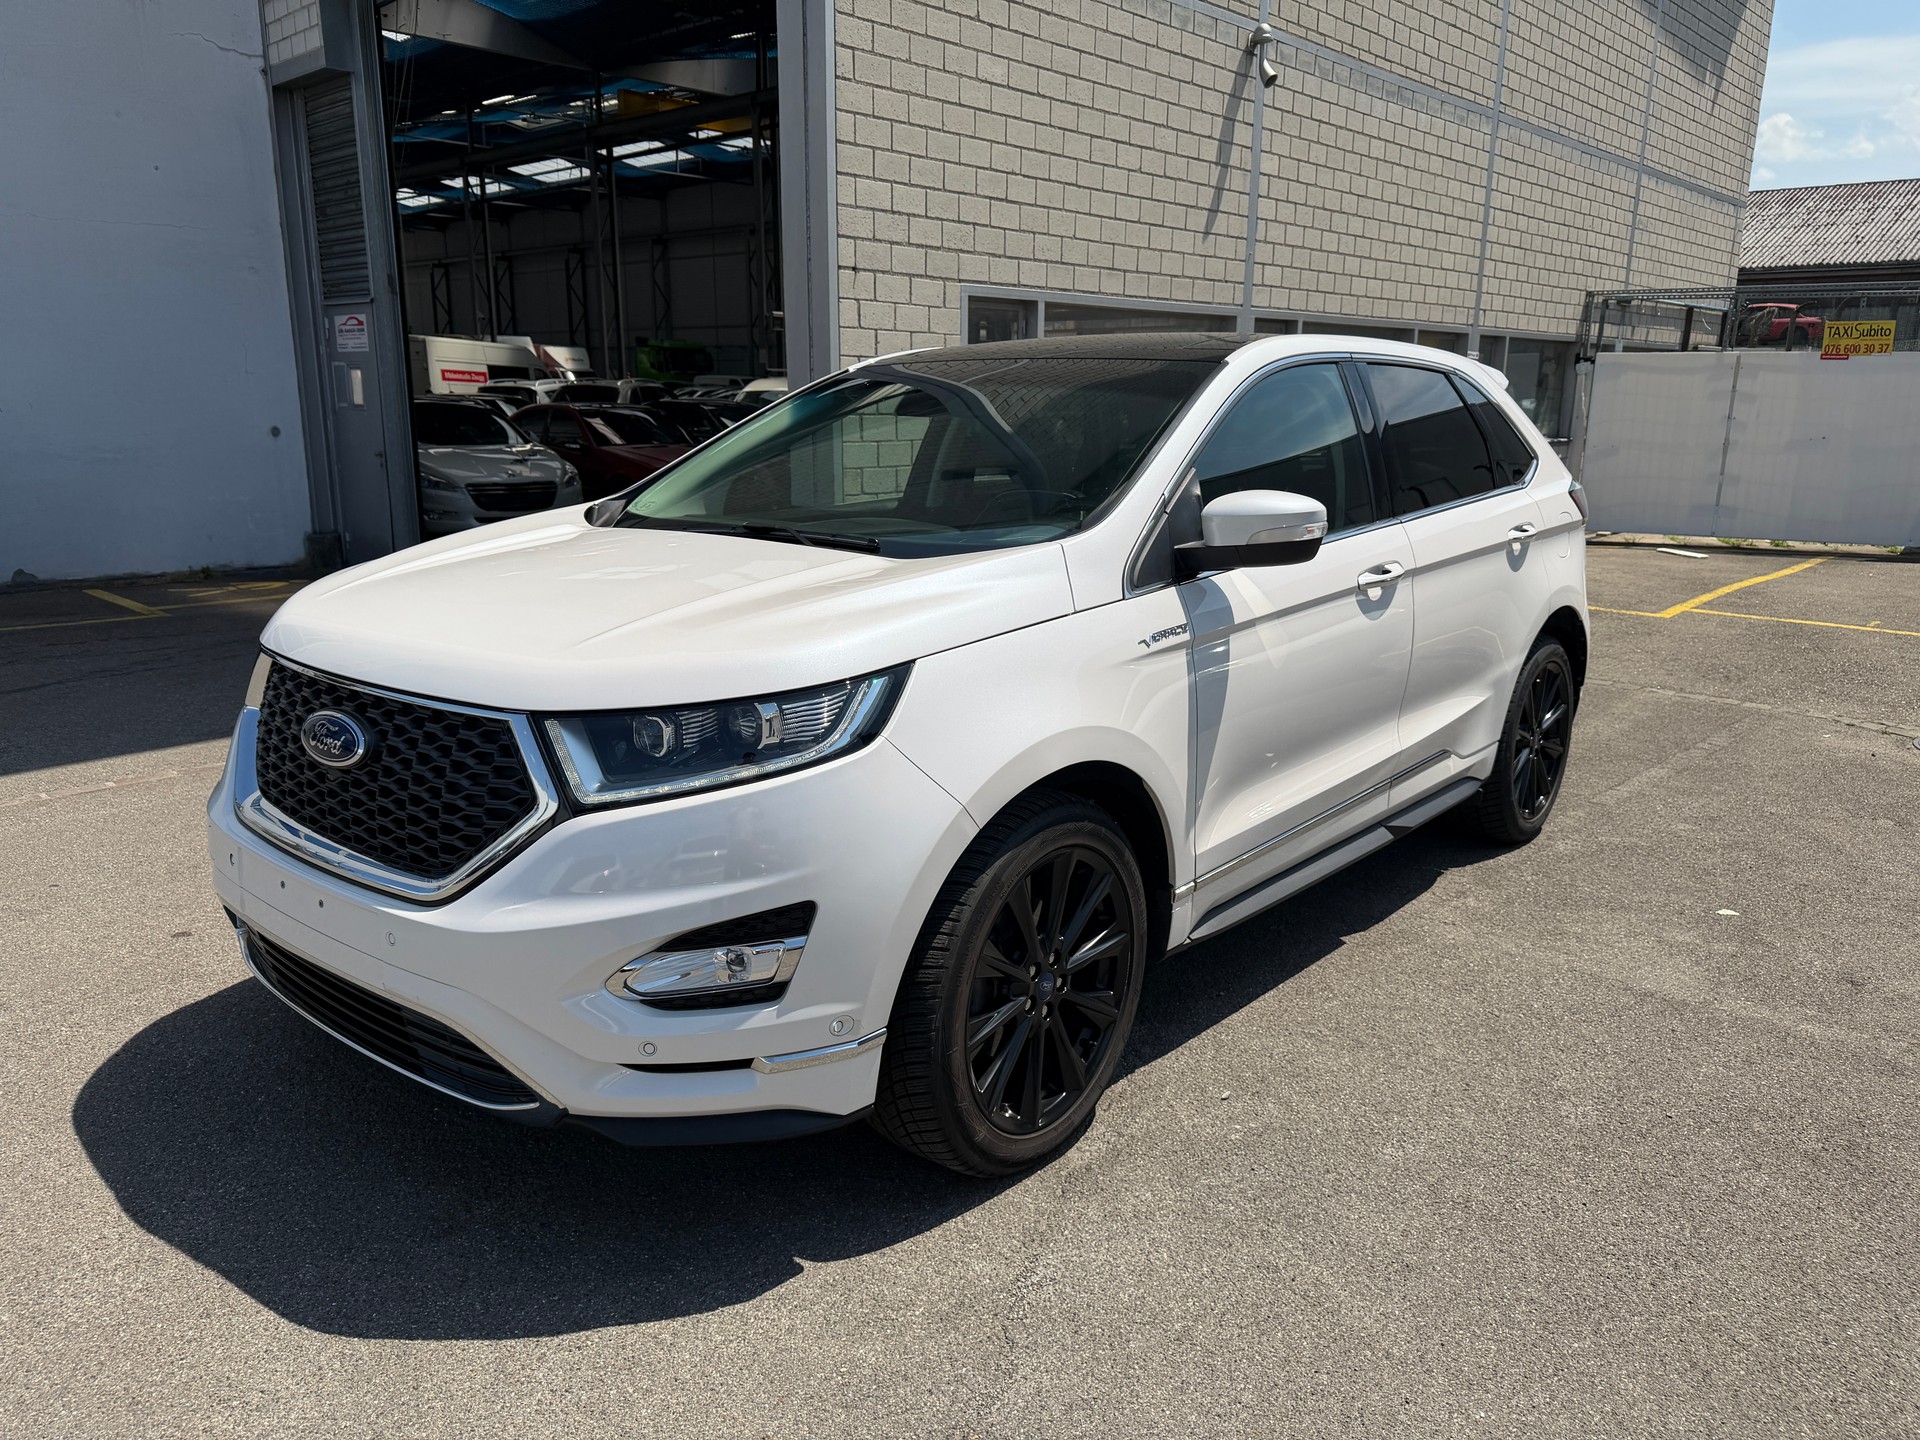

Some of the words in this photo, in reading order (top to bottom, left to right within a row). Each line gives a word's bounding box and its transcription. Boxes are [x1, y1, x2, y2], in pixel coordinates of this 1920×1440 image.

[1824, 344, 1841, 354] 076
[1844, 343, 1861, 354] 600
[1863, 343, 1876, 354] 30
[1877, 343, 1890, 353] 37
[309, 721, 345, 755] Ford
